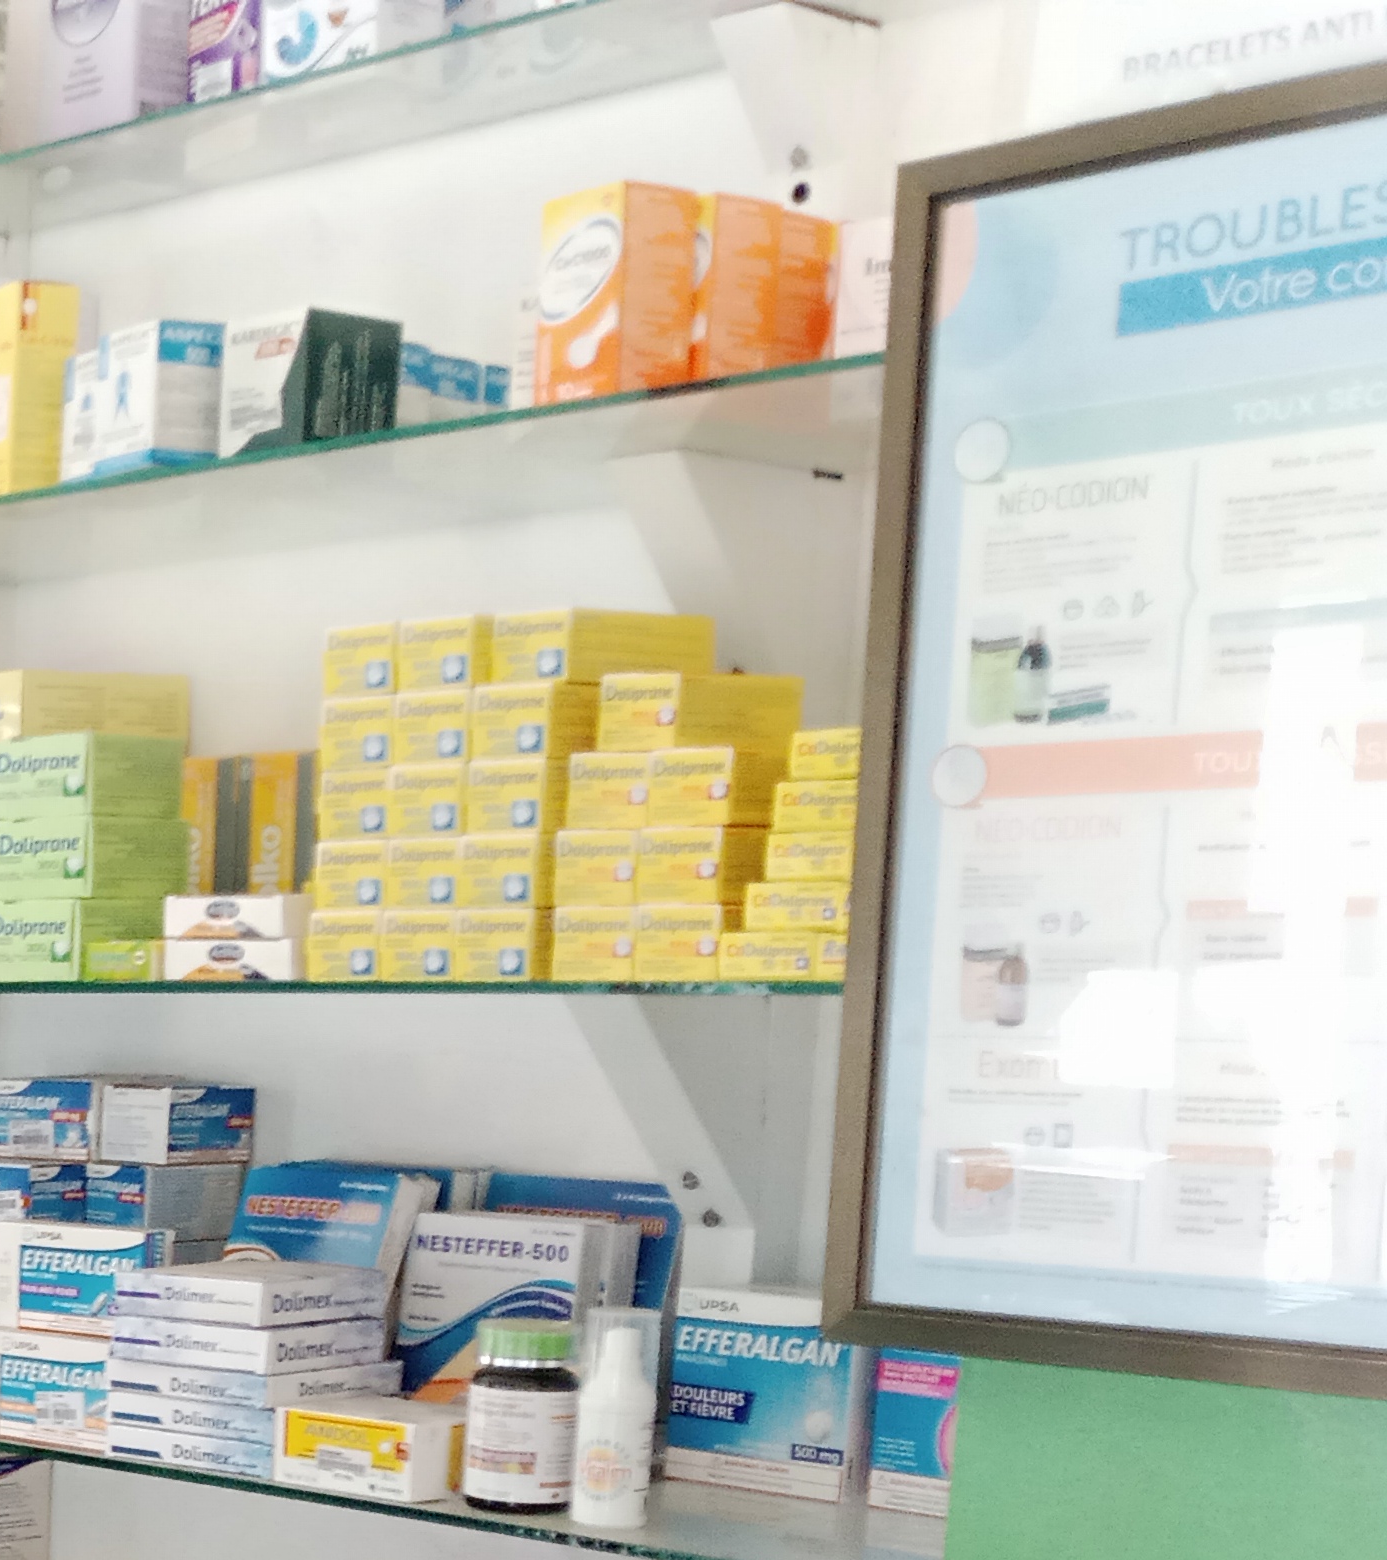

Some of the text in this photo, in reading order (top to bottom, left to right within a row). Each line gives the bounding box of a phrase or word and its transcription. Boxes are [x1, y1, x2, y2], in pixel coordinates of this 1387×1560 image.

[1201, 268, 1317, 312] Votre
[0, 834, 80, 856] Doliprane
[416, 1232, 570, 1262] NESTEFFER-500
[22, 1249, 135, 1274] EFFERALGAN
[273, 1291, 336, 1314] Dolimex
[699, 1300, 740, 1313] UPSA
[277, 1339, 336, 1363] Dolimex
[679, 1325, 843, 1367] EFFERALGAN
[170, 1377, 227, 1399] Dolimex
[673, 1386, 746, 1405] DOULEURS
[172, 1409, 231, 1429] Dolimex
[672, 1401, 735, 1420] ET FIÈVRE
[172, 1443, 232, 1465] Dolimex
